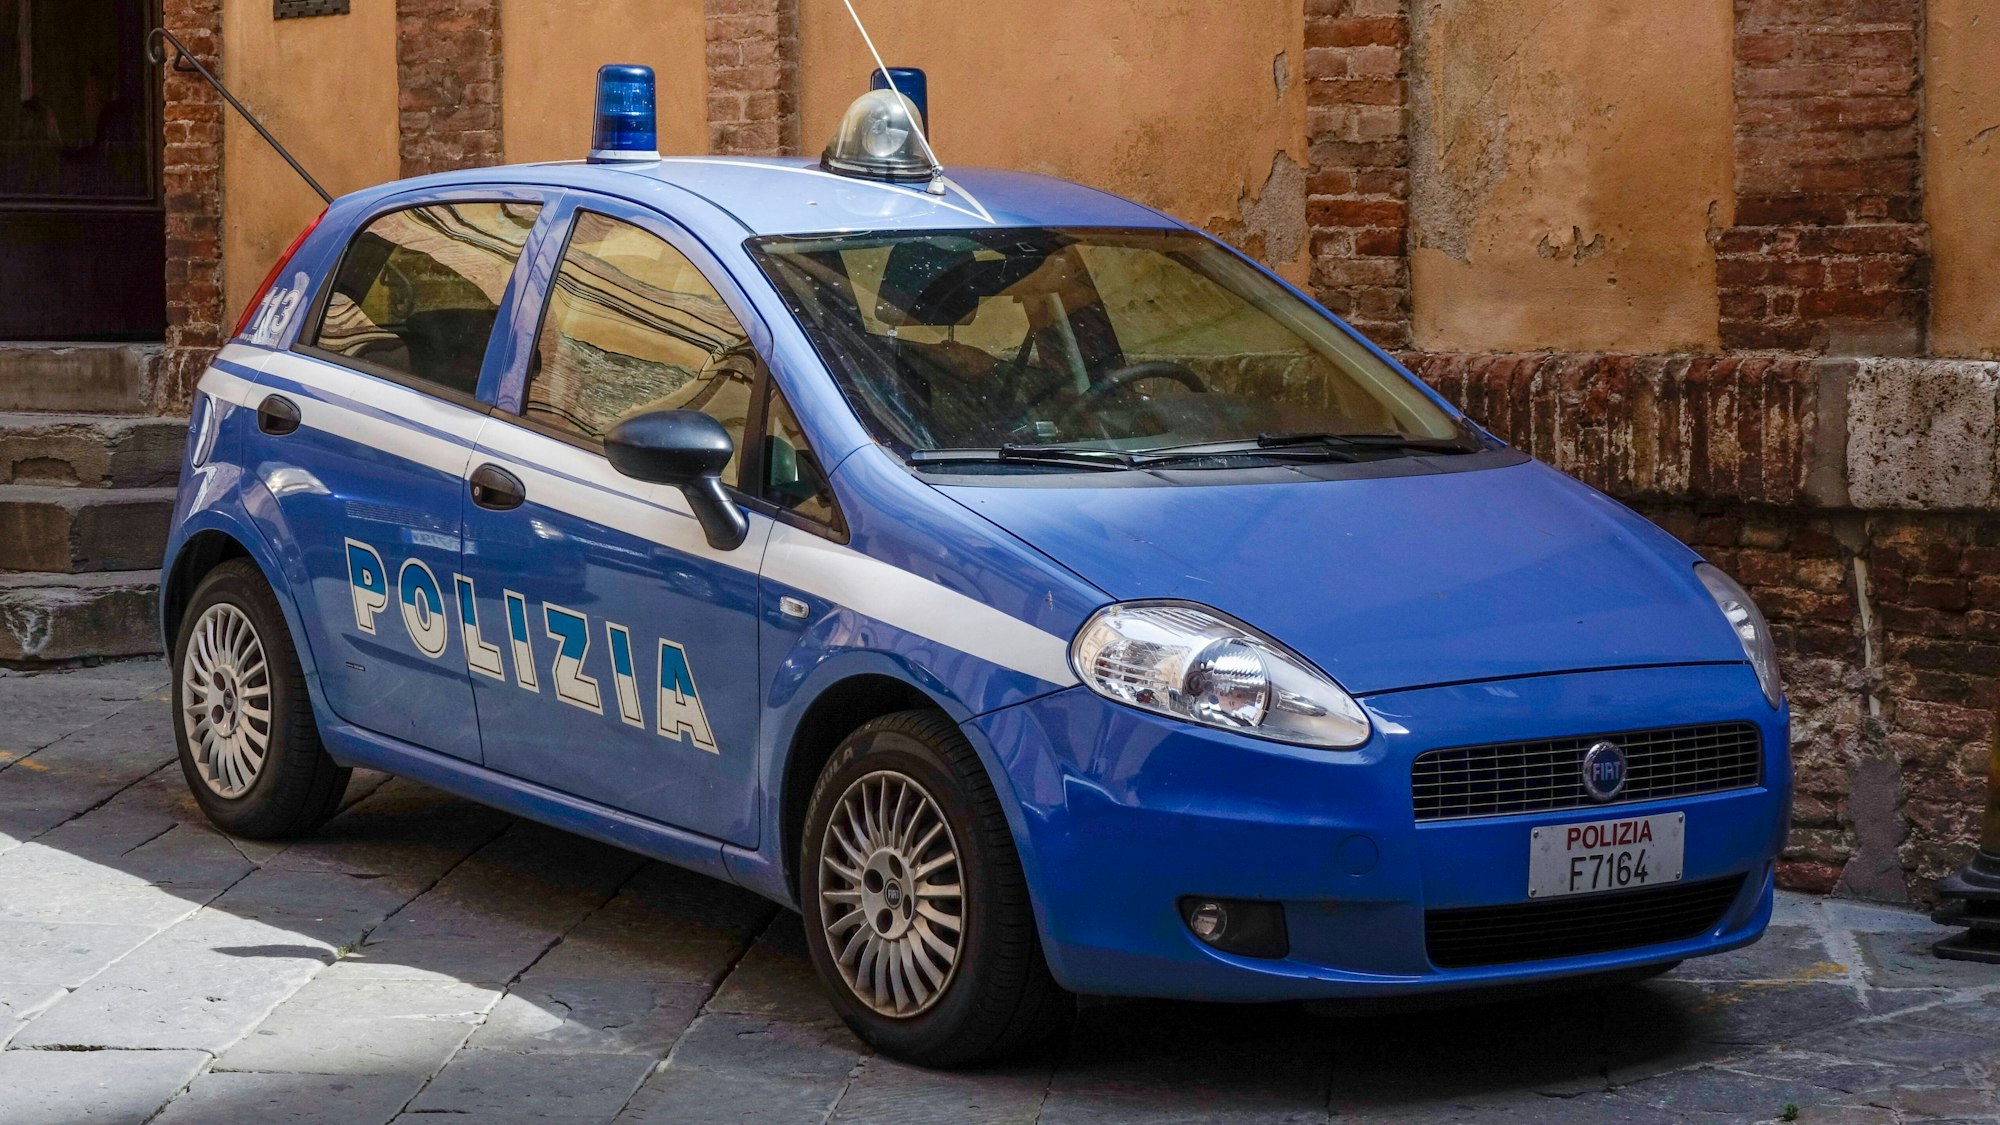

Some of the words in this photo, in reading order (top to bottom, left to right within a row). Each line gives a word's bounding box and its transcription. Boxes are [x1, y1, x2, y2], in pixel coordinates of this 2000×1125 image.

[252, 286, 300, 335] 113
[344, 536, 720, 755] POLIZIA
[1592, 761, 1621, 782] FIAT
[1567, 820, 1653, 850] POLIZIA
[1569, 849, 1648, 892] F7164
[888, 889, 899, 900] FIAT
